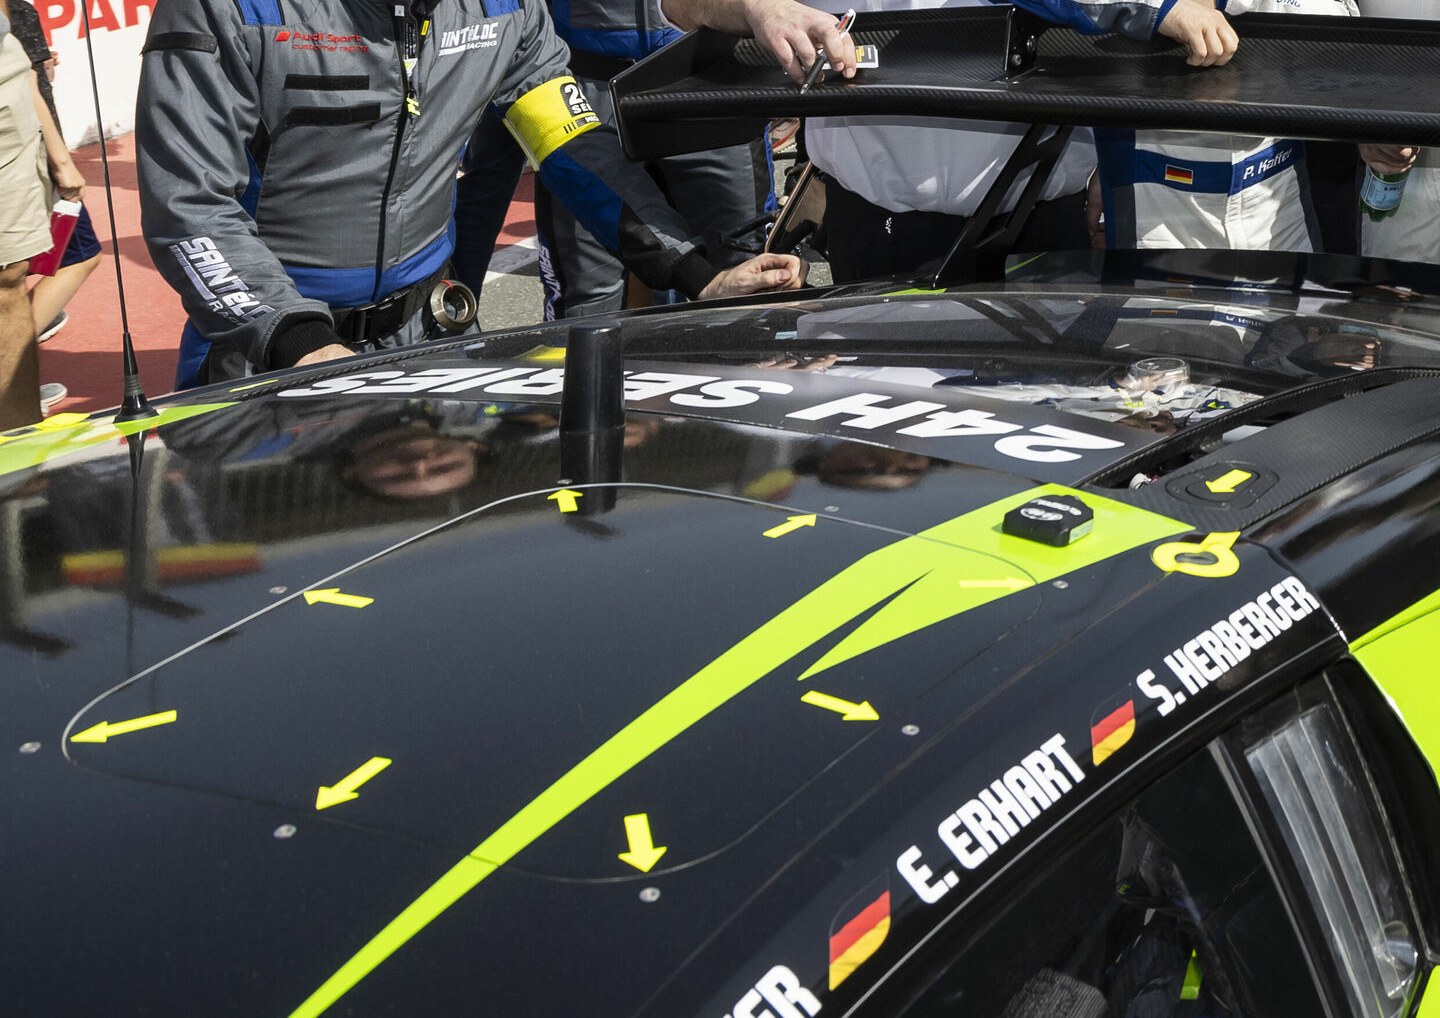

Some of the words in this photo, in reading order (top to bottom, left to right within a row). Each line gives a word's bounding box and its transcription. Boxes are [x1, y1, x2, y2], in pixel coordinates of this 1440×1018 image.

[293, 32, 324, 42] Audi
[327, 33, 361, 44] Sport
[339, 44, 369, 54] racing
[1243, 166, 1256, 180] P.
[1256, 147, 1293, 178] Kaffer
[787, 393, 1126, 463] 24H
[1163, 576, 1320, 702] HERBERGER
[895, 845, 959, 904] E.
[937, 733, 1085, 869] ERHART
